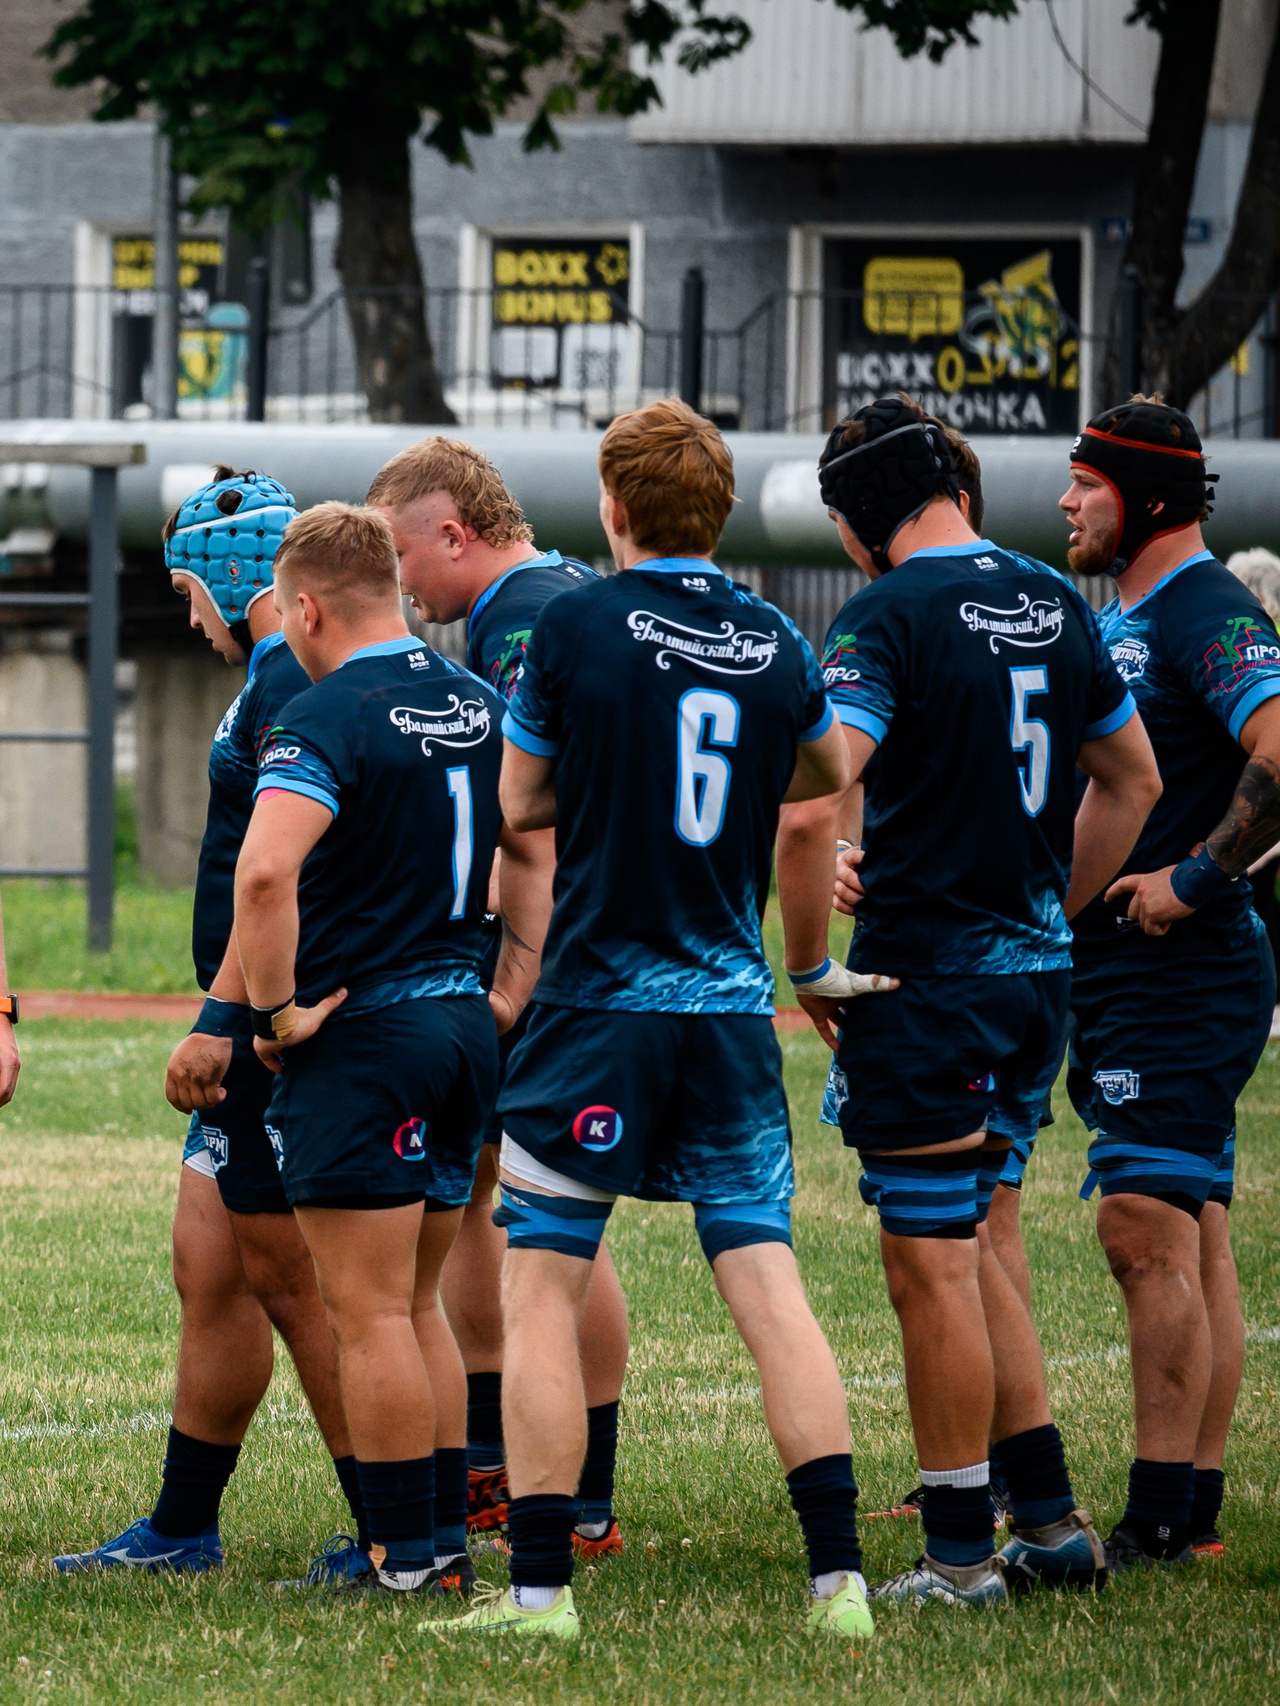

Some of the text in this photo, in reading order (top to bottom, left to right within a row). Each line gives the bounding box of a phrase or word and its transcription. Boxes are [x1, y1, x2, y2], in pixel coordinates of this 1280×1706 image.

[627, 610, 734, 659] Балтийский
[823, 667, 860, 682] ПРО
[674, 687, 740, 847] 6
[1009, 665, 1050, 818] 5
[446, 765, 474, 920] 1
